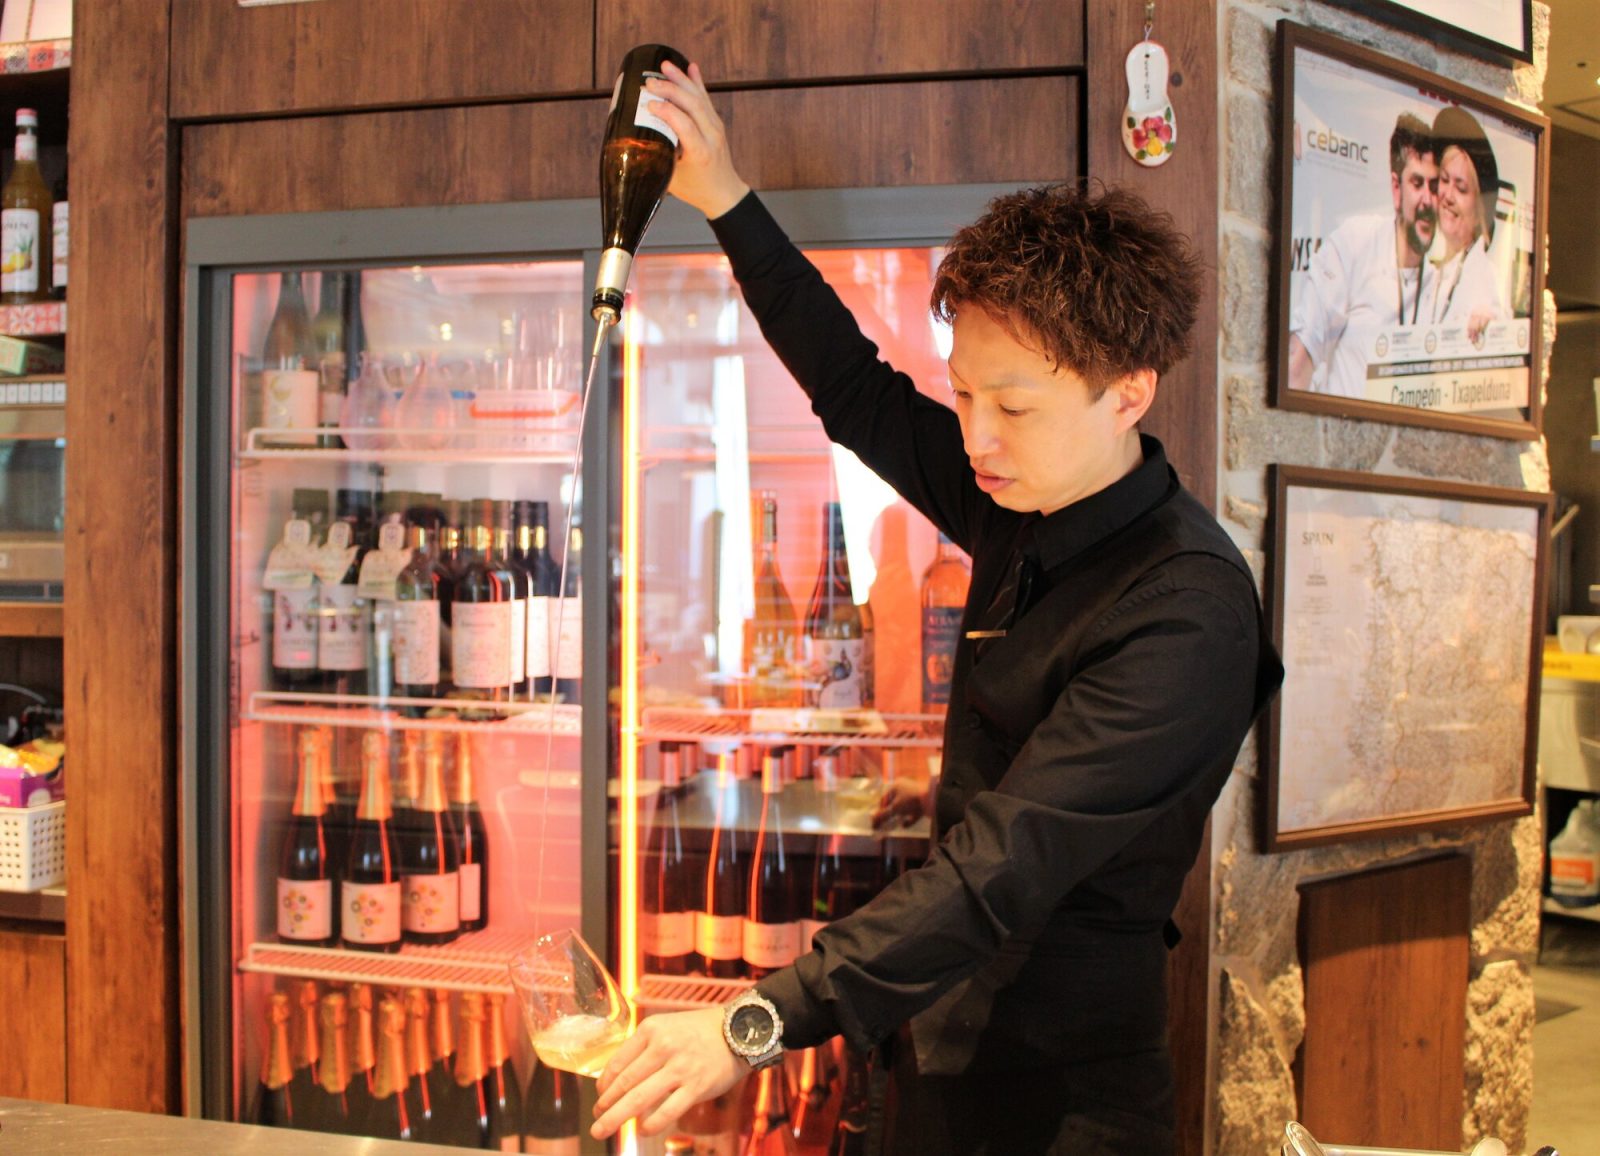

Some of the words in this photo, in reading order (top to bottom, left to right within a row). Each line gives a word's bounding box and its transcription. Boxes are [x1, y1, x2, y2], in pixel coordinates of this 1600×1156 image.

[1307, 128, 1369, 164] cebanc
[1391, 381, 1442, 409] Campeón
[1451, 376, 1512, 409] Txapelduna
